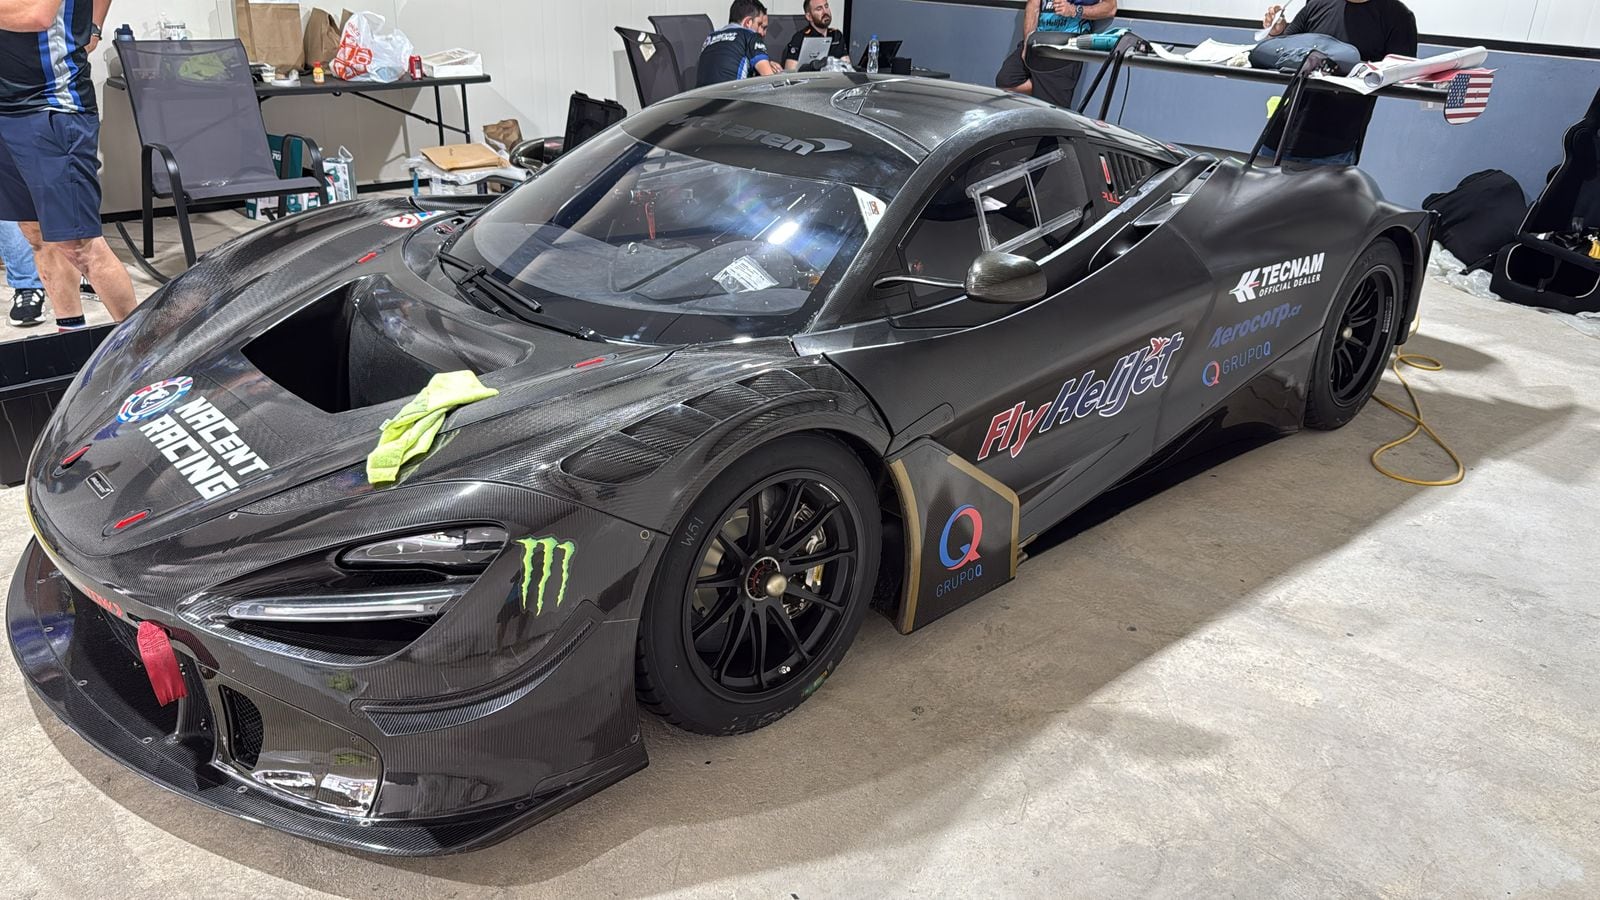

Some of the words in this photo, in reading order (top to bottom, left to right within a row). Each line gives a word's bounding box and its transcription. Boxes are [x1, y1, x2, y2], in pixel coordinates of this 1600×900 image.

[1259, 281, 1291, 298] OFFICIAL
[1293, 273, 1321, 287] DEALER
[1261, 252, 1325, 287] TECNAM
[1207, 302, 1303, 349] Aerocorp.cr
[139, 413, 240, 500] RACING
[175, 396, 270, 476] NACENT
